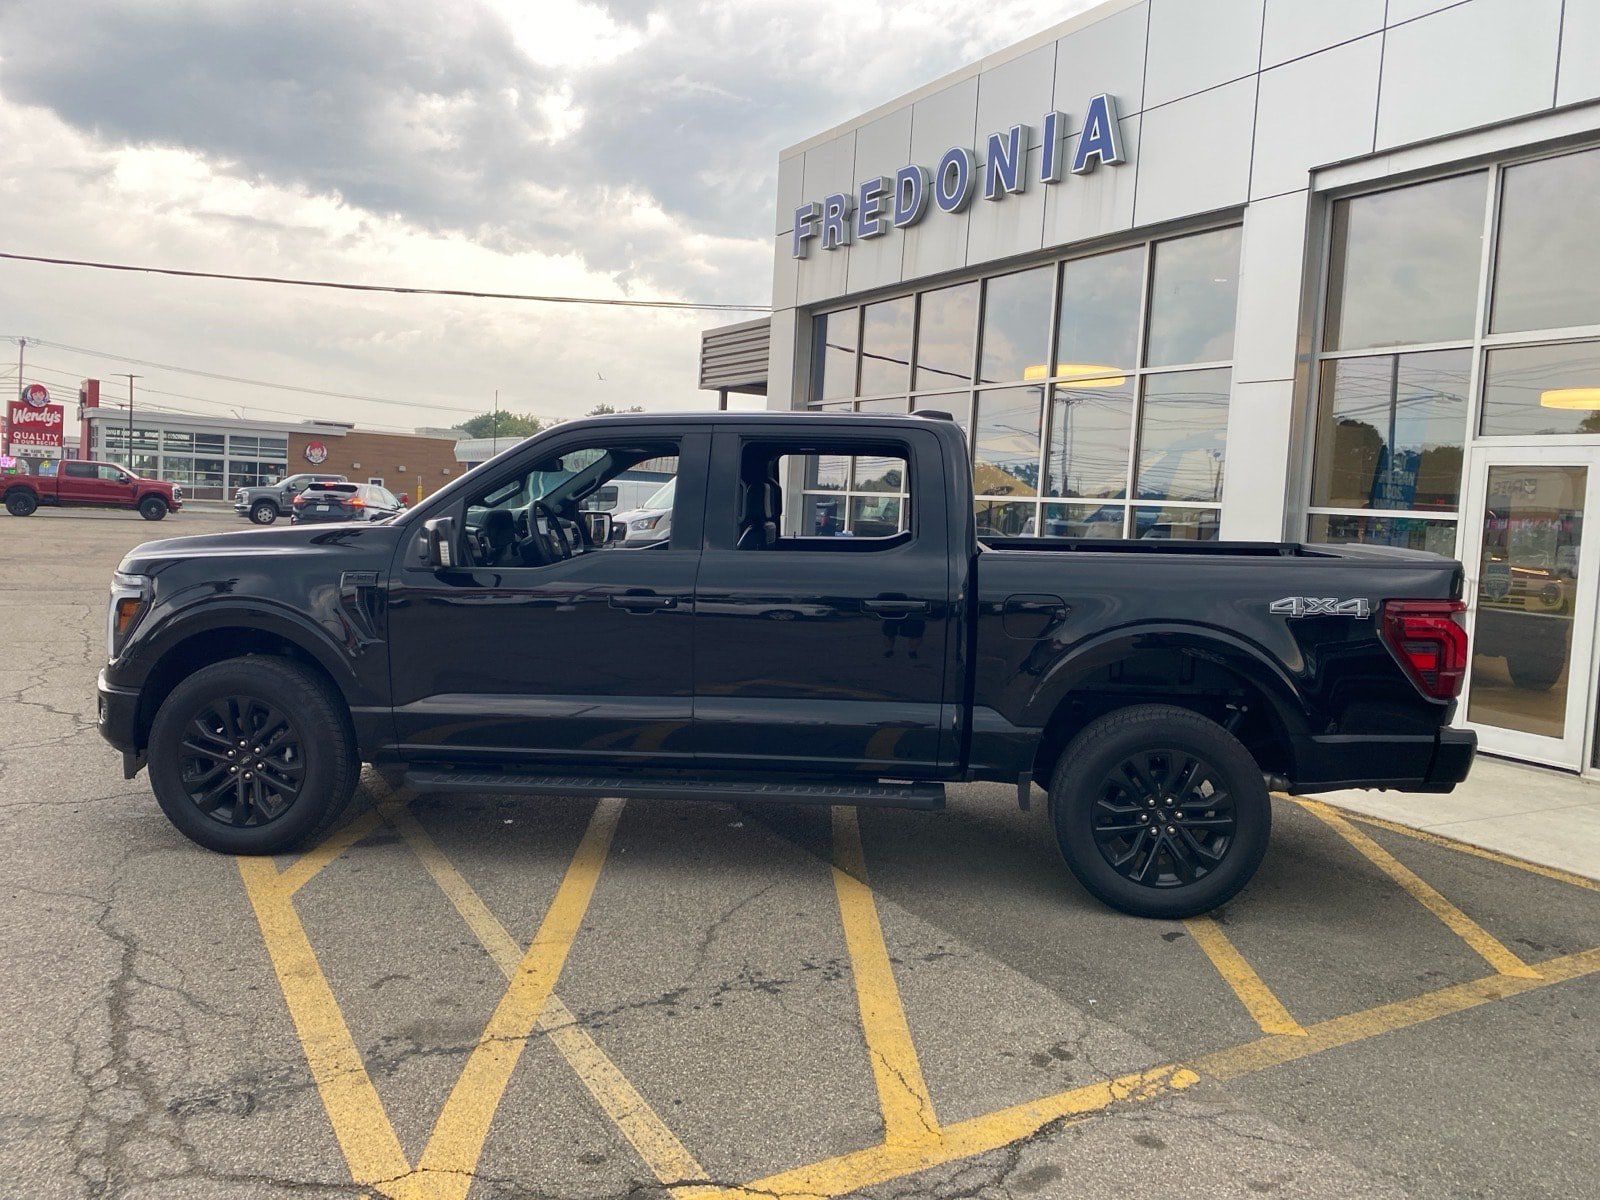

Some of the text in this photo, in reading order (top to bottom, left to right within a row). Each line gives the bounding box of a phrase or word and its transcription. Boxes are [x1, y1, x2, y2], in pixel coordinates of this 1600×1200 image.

[792, 93, 1125, 261] FREDONIA
[12, 407, 61, 427] Wendy's
[13, 431, 59, 441] QUALITY
